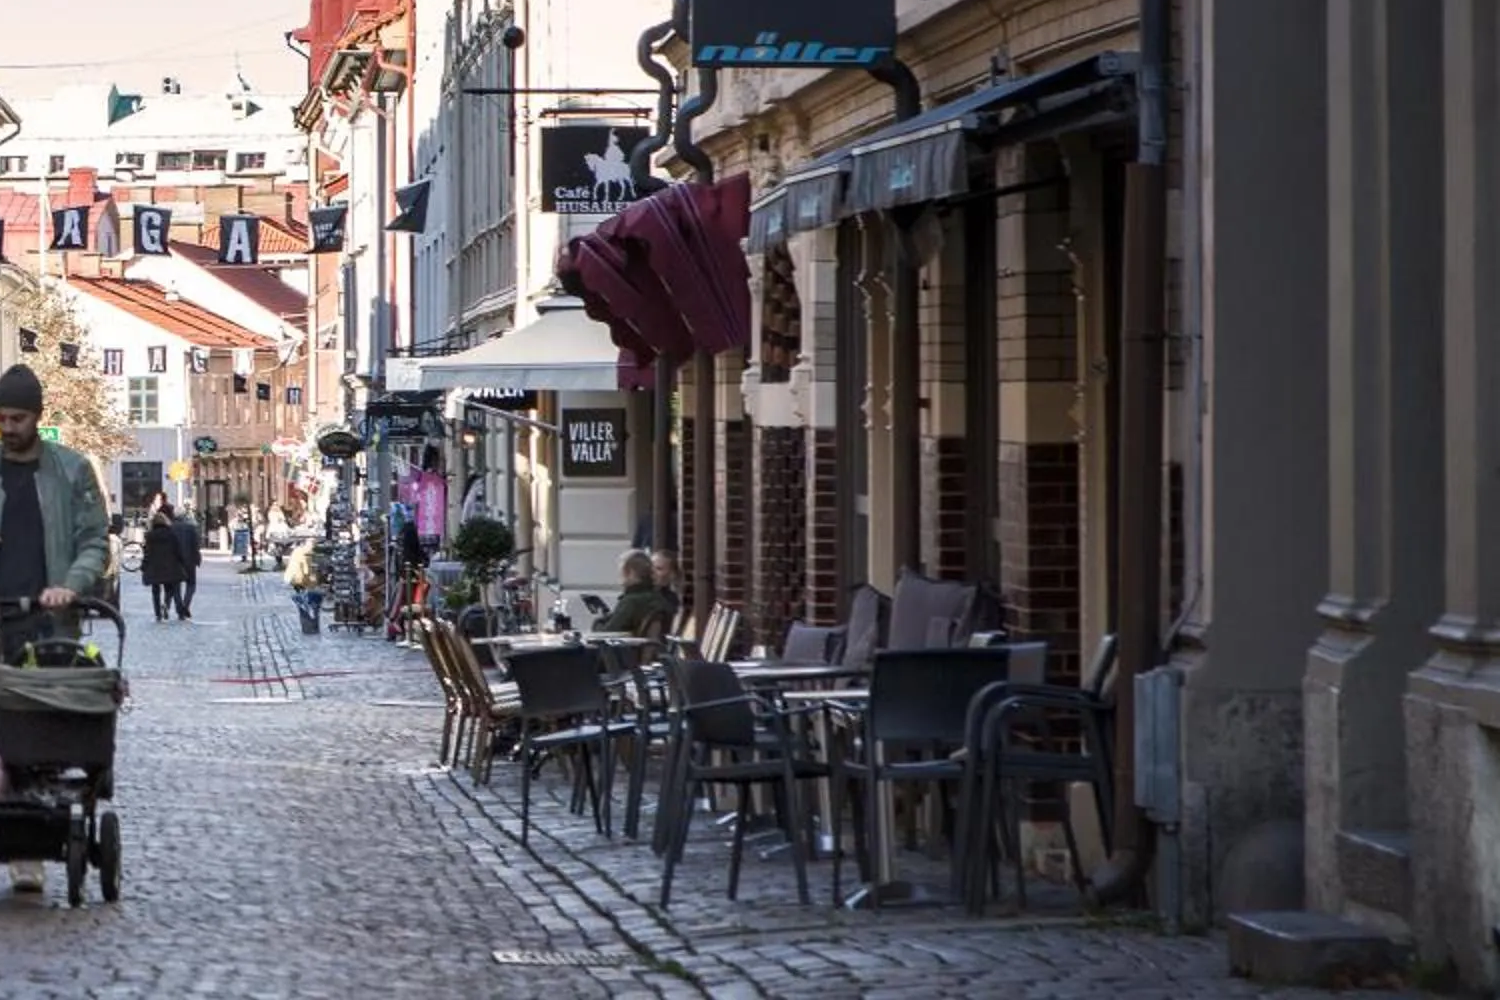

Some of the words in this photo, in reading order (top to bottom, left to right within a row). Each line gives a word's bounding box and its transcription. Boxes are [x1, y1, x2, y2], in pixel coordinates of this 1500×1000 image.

[554, 185, 591, 199] Café
[555, 201, 629, 213] HUSARE
[568, 421, 616, 442] VILLER
